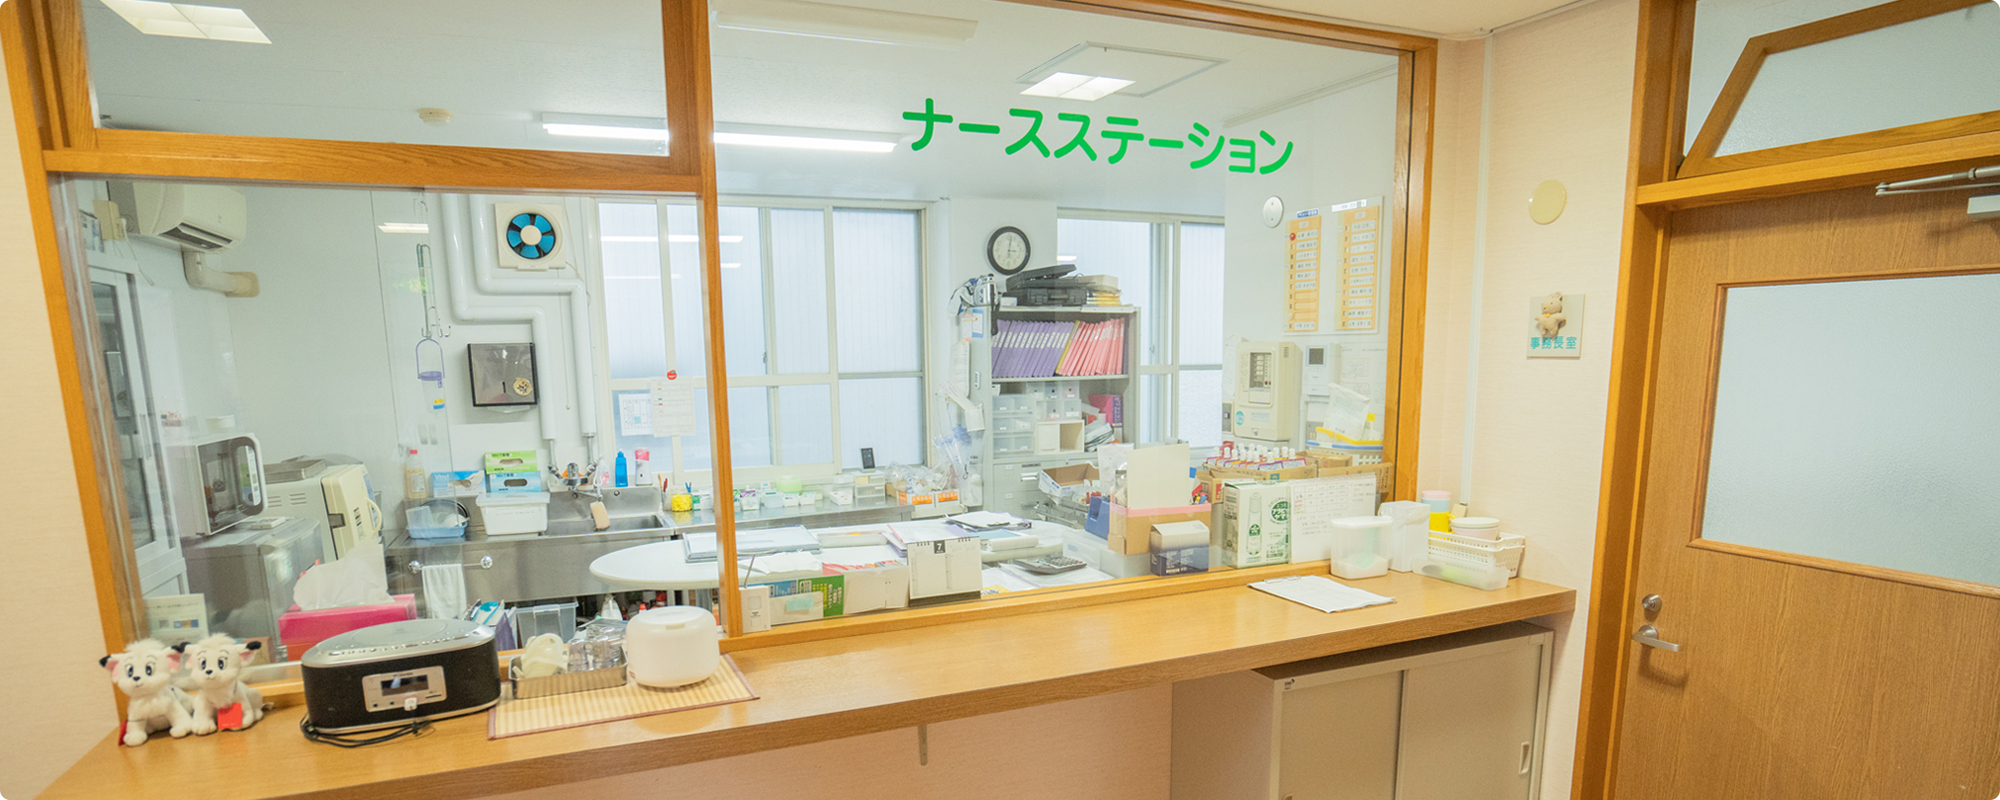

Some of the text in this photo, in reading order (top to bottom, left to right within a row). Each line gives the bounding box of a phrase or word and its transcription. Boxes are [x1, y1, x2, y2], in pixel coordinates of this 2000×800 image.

[903, 98, 1293, 174] ナースステーション
[1530, 336, 1577, 350] 事務長室
[936, 543, 943, 551] 7
